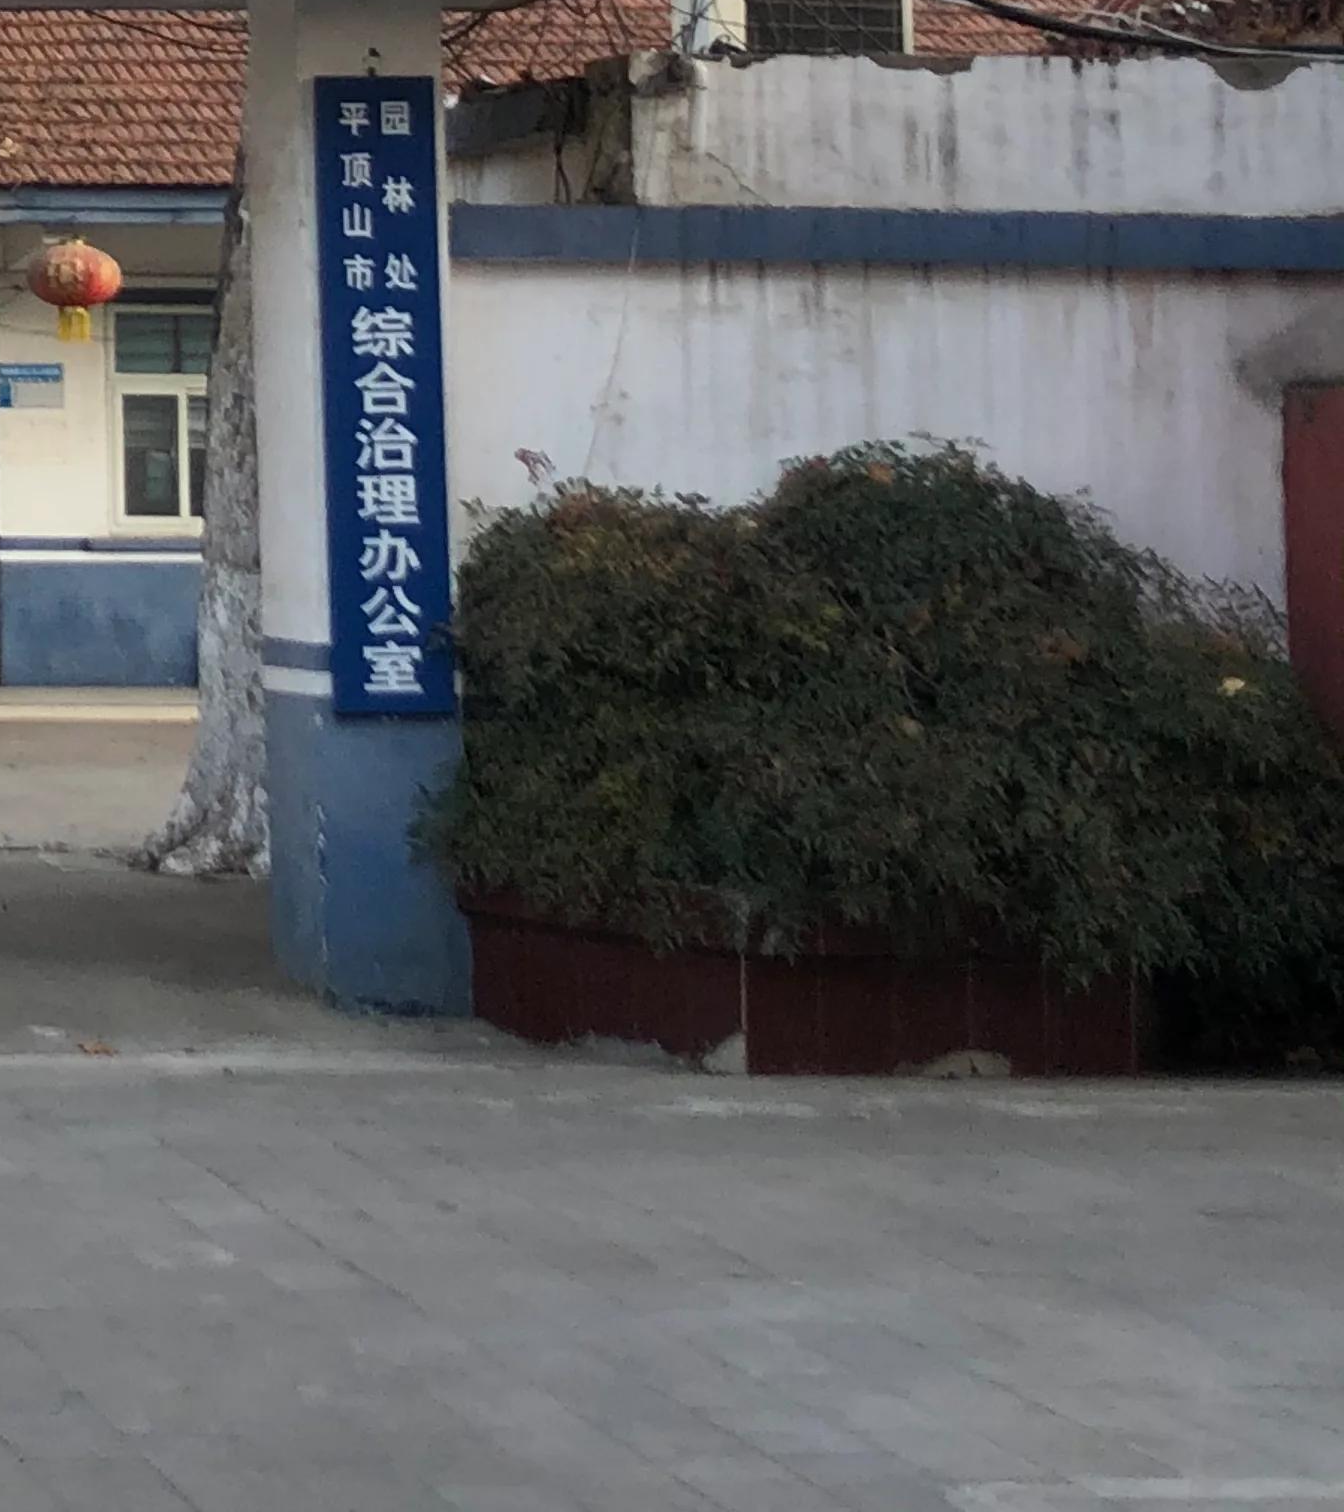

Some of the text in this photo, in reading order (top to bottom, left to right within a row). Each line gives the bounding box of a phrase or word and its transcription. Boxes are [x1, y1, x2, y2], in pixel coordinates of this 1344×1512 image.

[340, 102, 375, 291] 平顶山市
[381, 101, 417, 290] 园林处
[352, 305, 424, 694] 综合治理办公室
